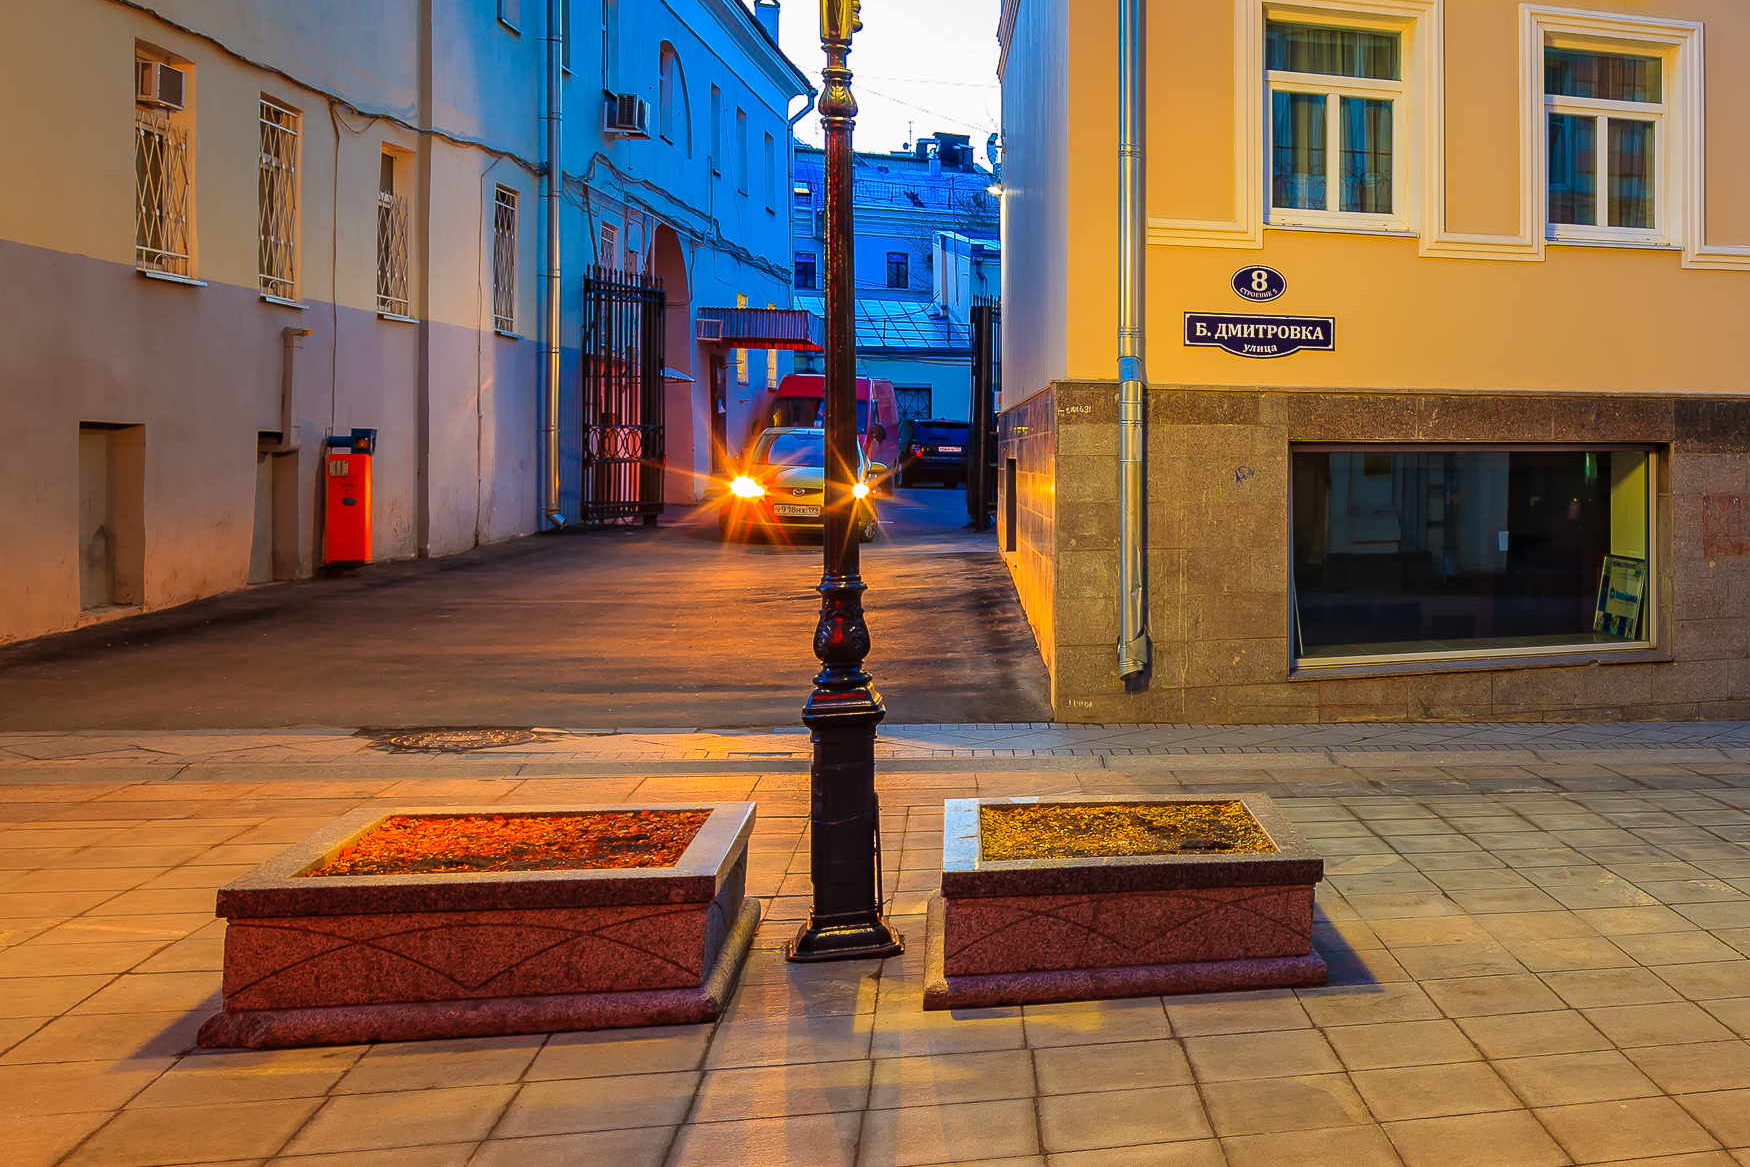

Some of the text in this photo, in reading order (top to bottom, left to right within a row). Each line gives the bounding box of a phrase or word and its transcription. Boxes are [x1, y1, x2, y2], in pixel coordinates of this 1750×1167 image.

[1251, 270, 1268, 292] 8
[1240, 287, 1273, 298] СТРОЕНИЕ
[1195, 322, 1324, 340] Б. ДМИТРОВКА
[1242, 343, 1278, 353] улица
